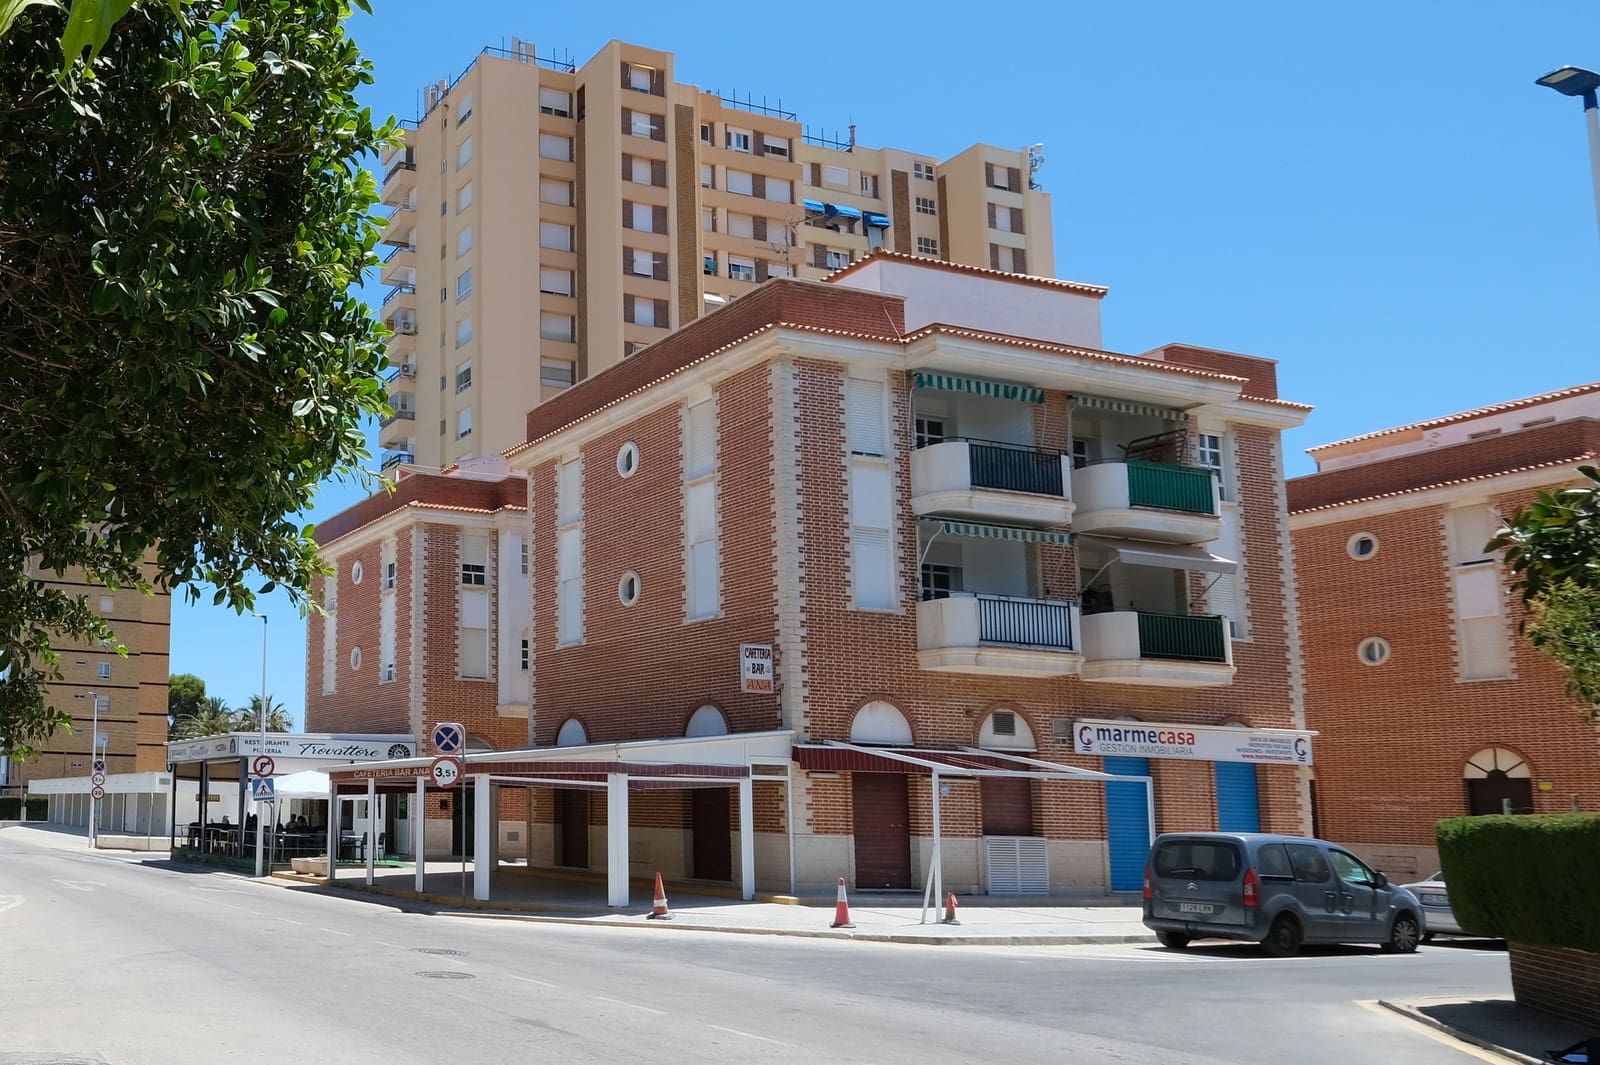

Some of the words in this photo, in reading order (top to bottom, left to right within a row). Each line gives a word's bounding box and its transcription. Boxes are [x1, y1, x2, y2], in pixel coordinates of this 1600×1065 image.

[745, 647, 771, 659] CAFETERIA
[751, 663, 765, 675] BAR
[746, 679, 771, 690] ANA
[1096, 727, 1194, 745] marmecasa
[244, 739, 290, 747] RESTURANTE
[299, 743, 380, 757] Trovattore
[1100, 743, 1137, 753] GESTION
[1139, 745, 1194, 756] INMOBILIARIA
[353, 769, 393, 778] CAFETERIA
[394, 768, 411, 776] BAR
[412, 768, 430, 776] ANA
